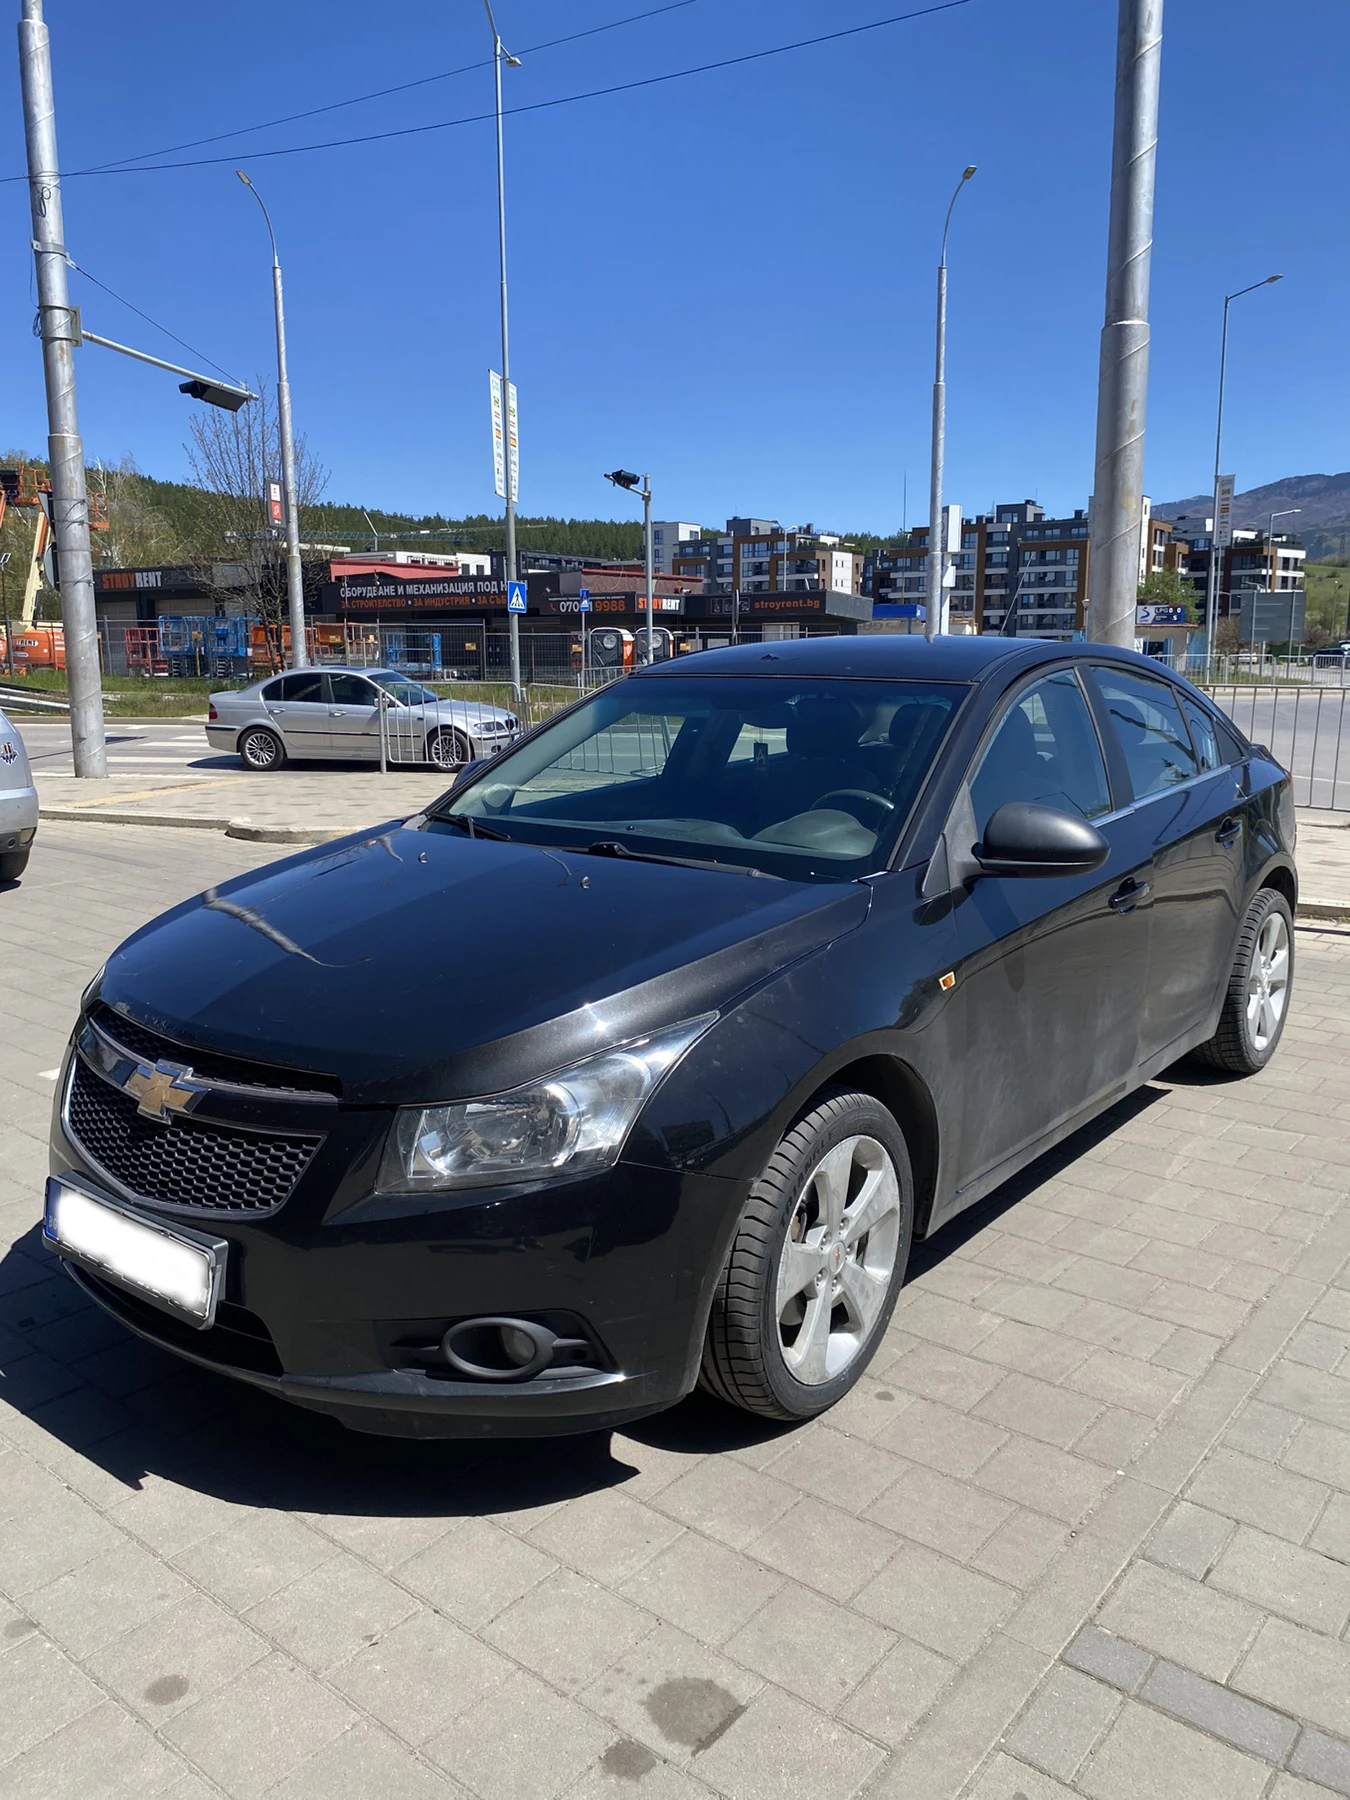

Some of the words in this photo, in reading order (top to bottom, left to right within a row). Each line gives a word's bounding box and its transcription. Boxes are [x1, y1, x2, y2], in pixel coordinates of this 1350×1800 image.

[102, 571, 161, 588] STROYRENT
[398, 585, 404, 595] И
[406, 582, 474, 595] МЕХАНИЗАЦИЯ
[477, 581, 498, 593] ПОД
[413, 598, 423, 606] ЗА
[425, 596, 470, 607] ИНДУСТРИЯ
[477, 595, 487, 604] ЗА
[595, 600, 626, 612] 9988
[638, 597, 680, 610] STOYRENT
[754, 599, 820, 610] stroyrent.bg
